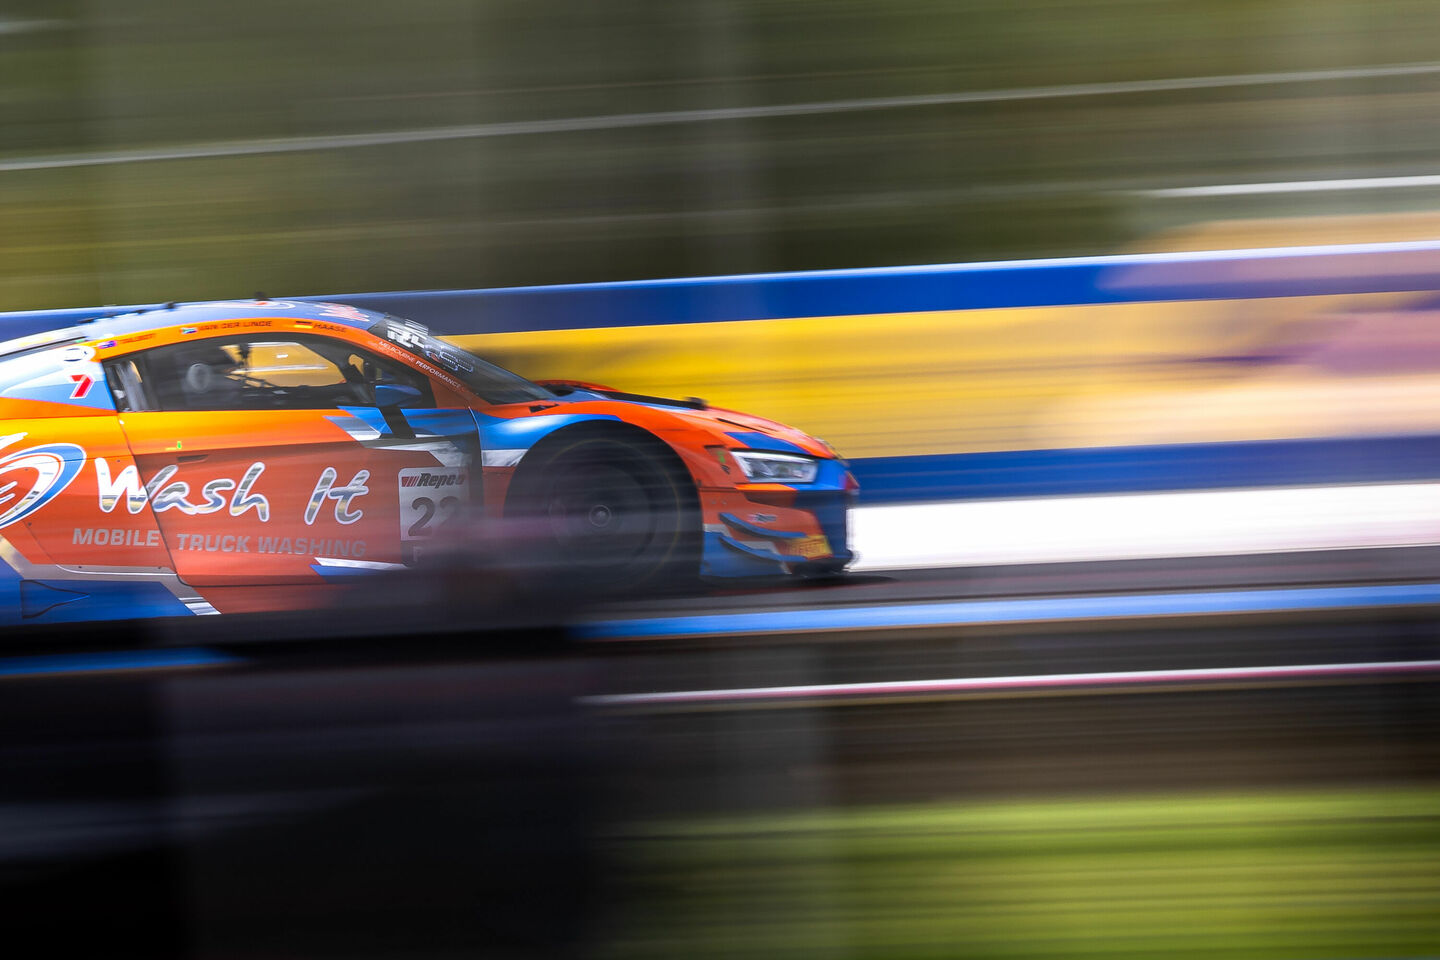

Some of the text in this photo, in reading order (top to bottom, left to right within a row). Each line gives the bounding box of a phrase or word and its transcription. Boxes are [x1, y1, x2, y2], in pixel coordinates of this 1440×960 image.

[415, 359, 462, 389] PERFORMANCE
[94, 456, 370, 525] Wash It
[417, 472, 465, 489] Repco
[72, 527, 368, 558] MOBILE TRUCK WASHING
